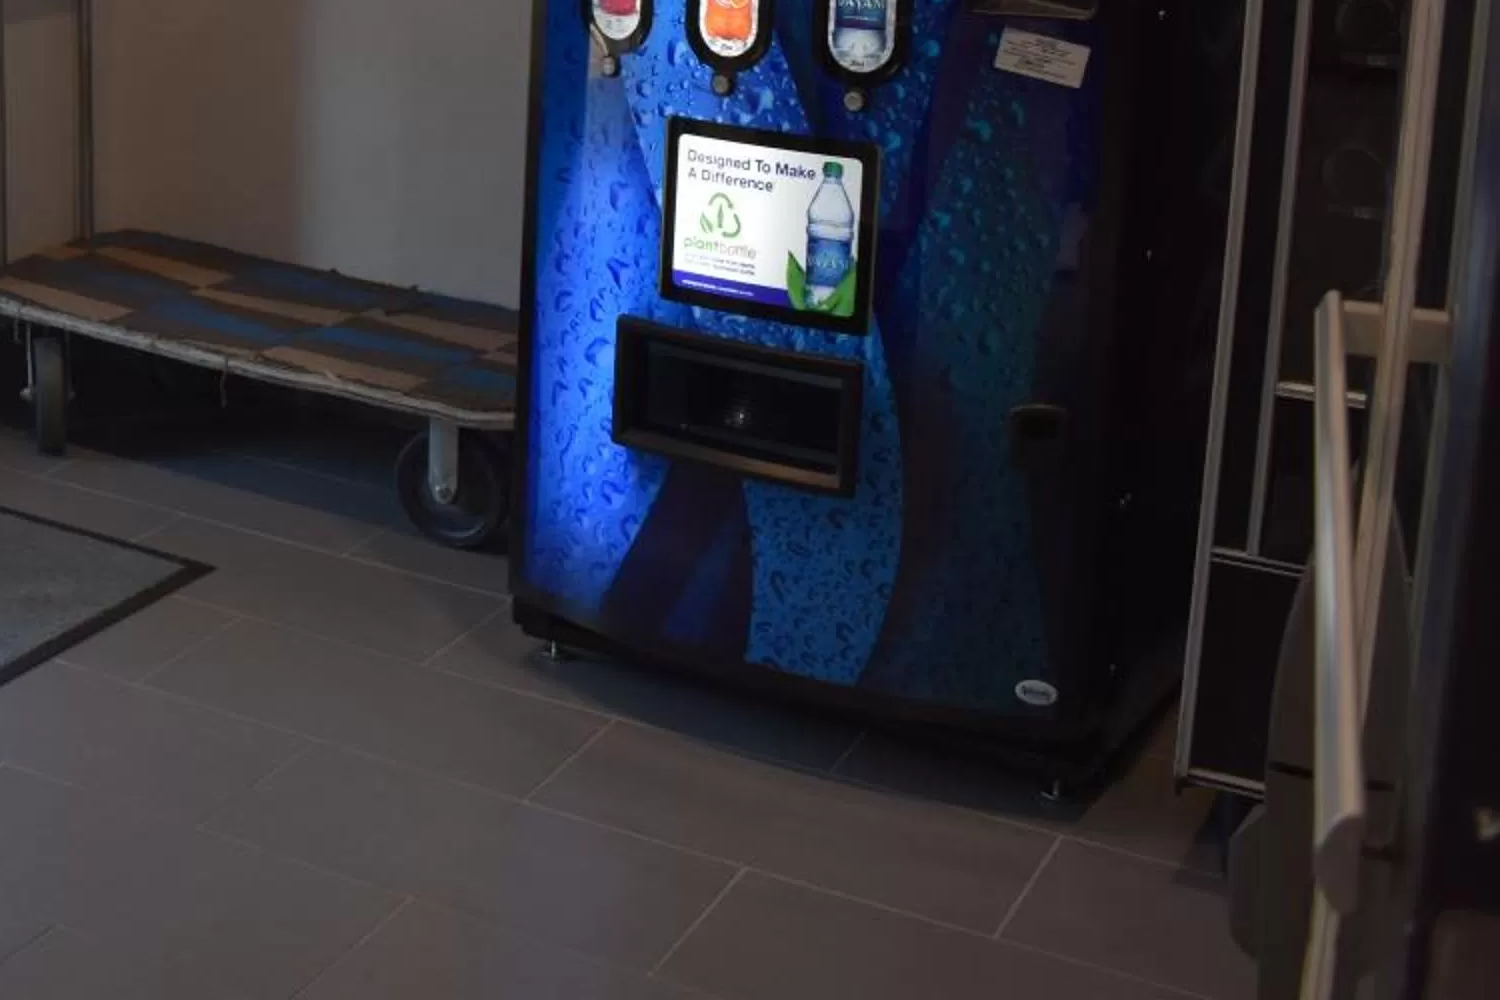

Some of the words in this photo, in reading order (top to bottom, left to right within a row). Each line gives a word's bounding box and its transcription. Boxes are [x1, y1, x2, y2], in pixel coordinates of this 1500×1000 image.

[687, 149, 751, 171] Designed
[755, 158, 771, 174] To
[775, 162, 817, 180] Make
[687, 167, 697, 179] A
[701, 169, 774, 192] Difference
